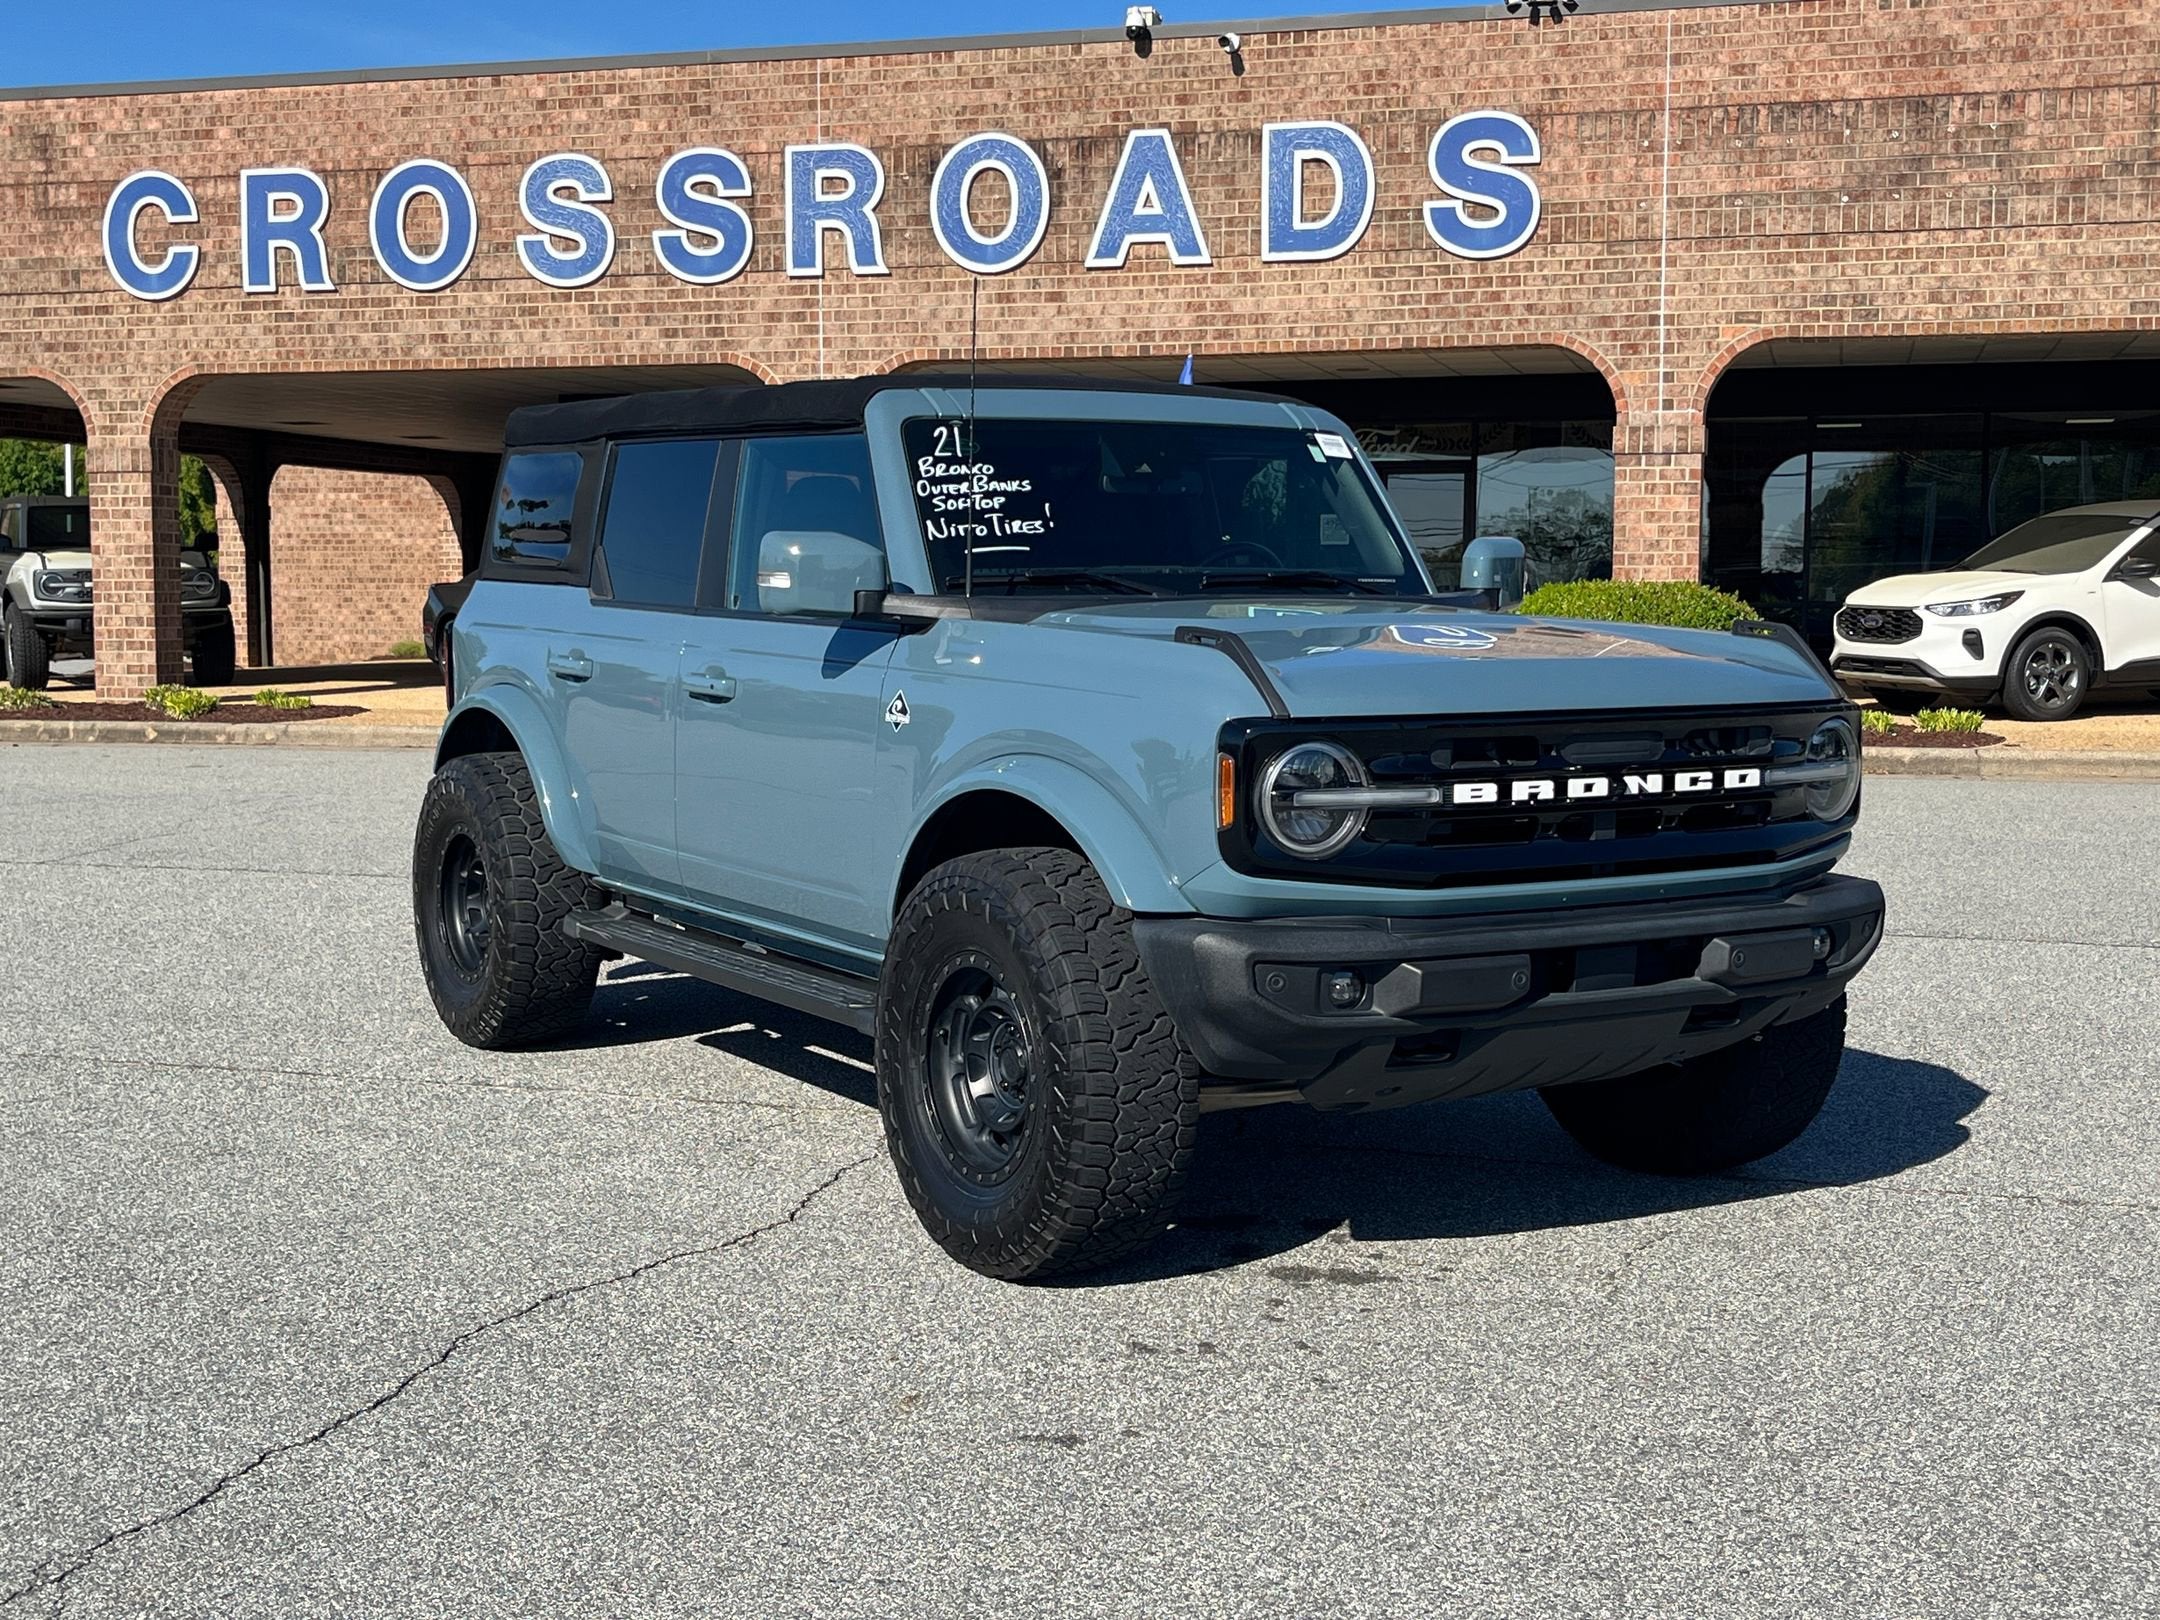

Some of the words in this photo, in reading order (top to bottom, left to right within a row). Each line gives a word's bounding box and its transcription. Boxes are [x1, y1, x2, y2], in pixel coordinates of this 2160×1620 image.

[101, 109, 1542, 302] CROSSROADS
[933, 426, 963, 457] 21
[1452, 767, 1762, 804] BRONCO
